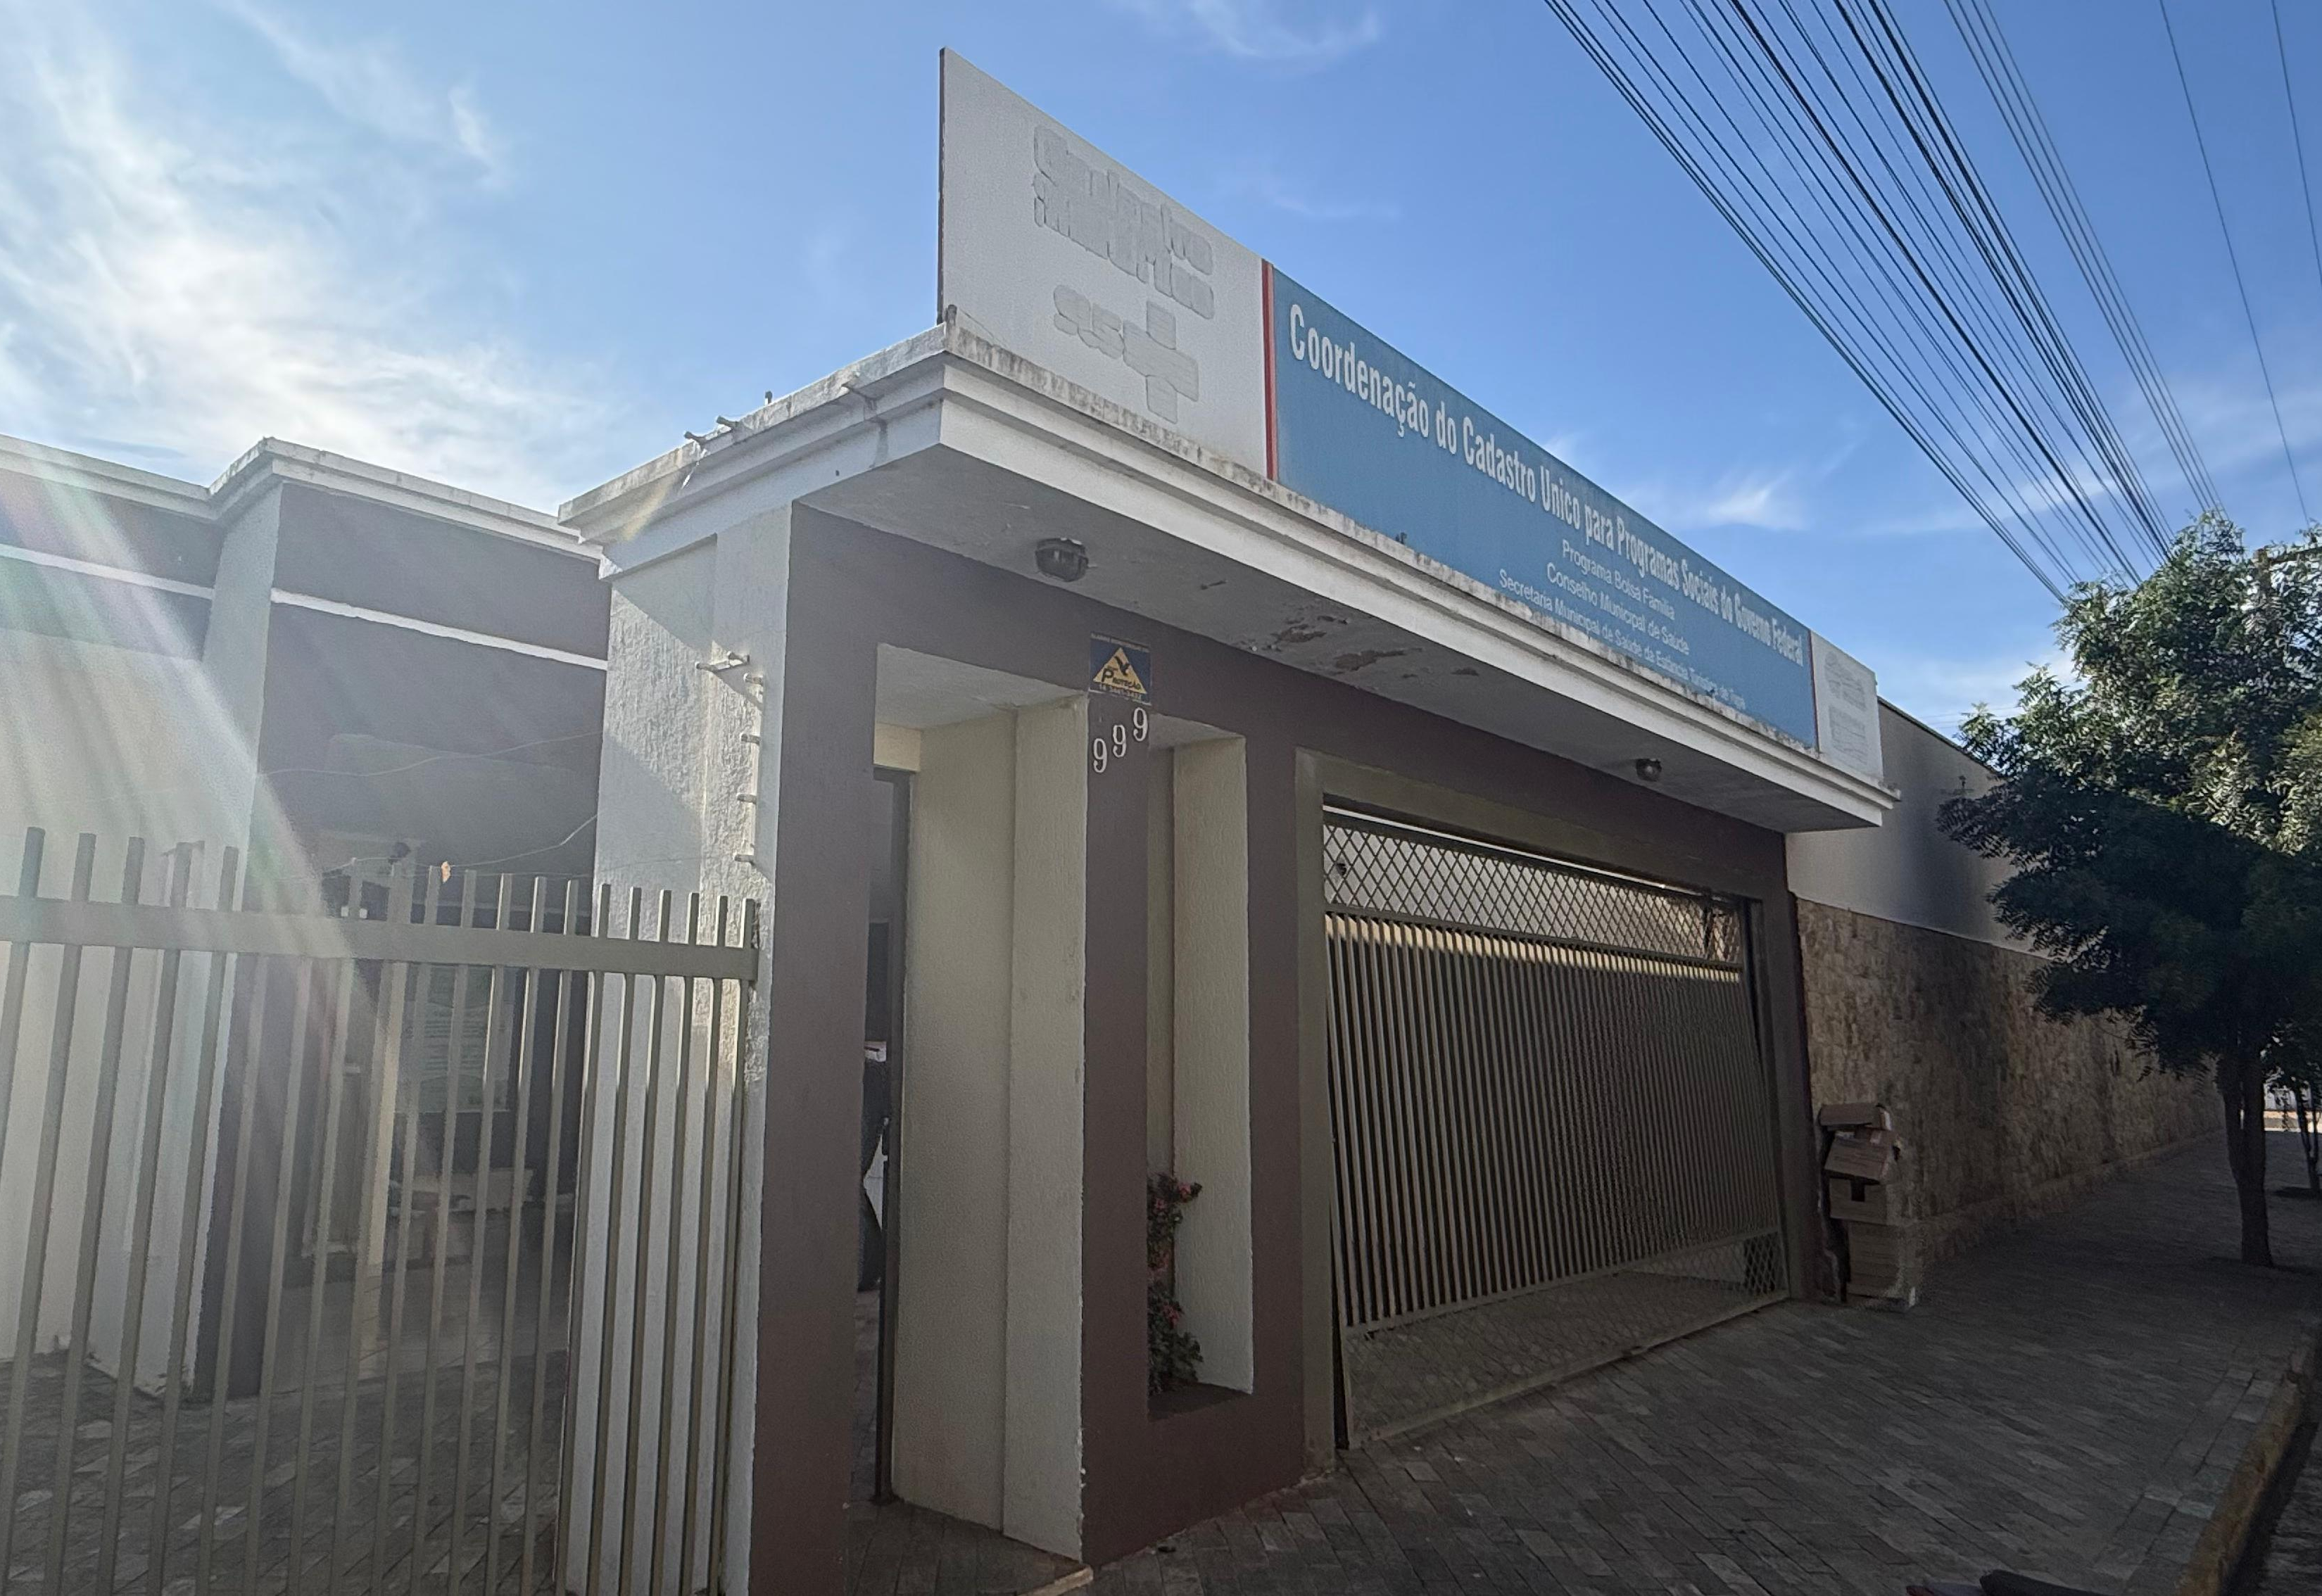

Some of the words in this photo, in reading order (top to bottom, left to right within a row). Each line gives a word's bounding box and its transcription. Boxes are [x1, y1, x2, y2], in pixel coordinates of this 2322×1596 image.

[1290, 304, 1429, 438] Coordenação
[1436, 400, 1457, 455] do
[1463, 417, 1536, 502] Cadastro
[1584, 504, 1614, 551] para
[1617, 516, 1680, 591] Programas
[1681, 559, 1719, 615] Sociais
[1720, 585, 1733, 624] do
[1734, 593, 1772, 647] Governo
[1771, 617, 1803, 667] Federal
[1499, 569, 1553, 612] Secretaria
[1554, 598, 1600, 635] Municipal
[1602, 624, 1613, 642] de
[1547, 562, 1598, 607] Conselho
[1599, 590, 1646, 632] Municipal
[1647, 619, 1660, 640] de
[1562, 539, 1613, 585] Programa
[1614, 570, 1641, 602] Bolsa
[1093, 707, 1148, 773] 999
